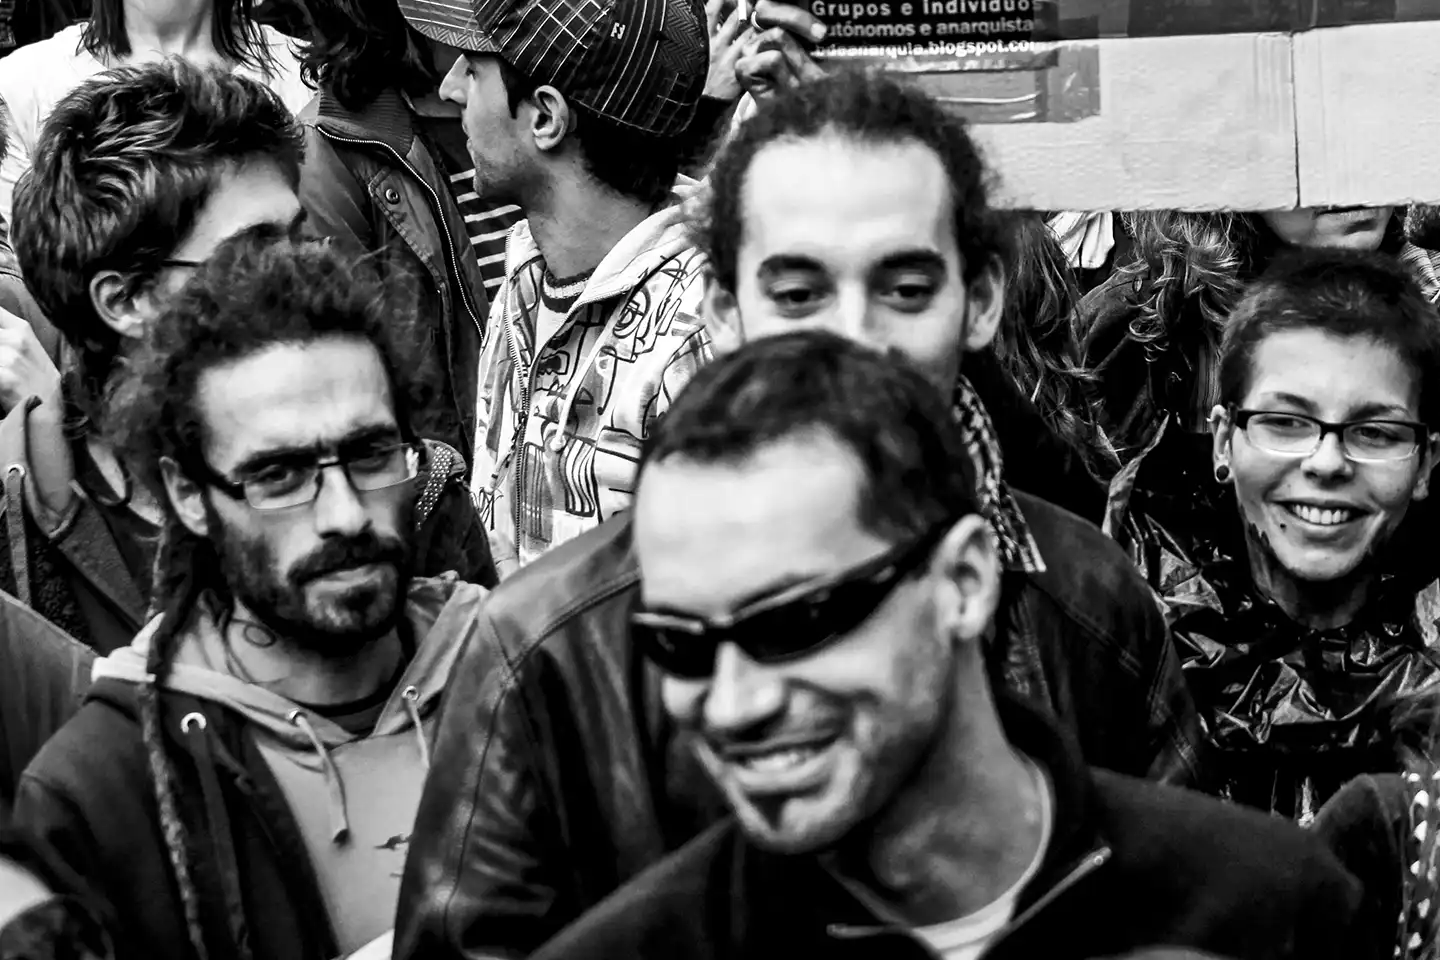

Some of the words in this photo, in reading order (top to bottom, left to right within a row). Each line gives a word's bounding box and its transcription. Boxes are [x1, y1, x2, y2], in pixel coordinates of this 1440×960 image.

[811, 0, 891, 19] Grupos
[901, 2, 913, 15] e
[826, 20, 916, 37] utónomos
[919, 22, 932, 36] e
[936, 17, 1045, 37] anarquista
